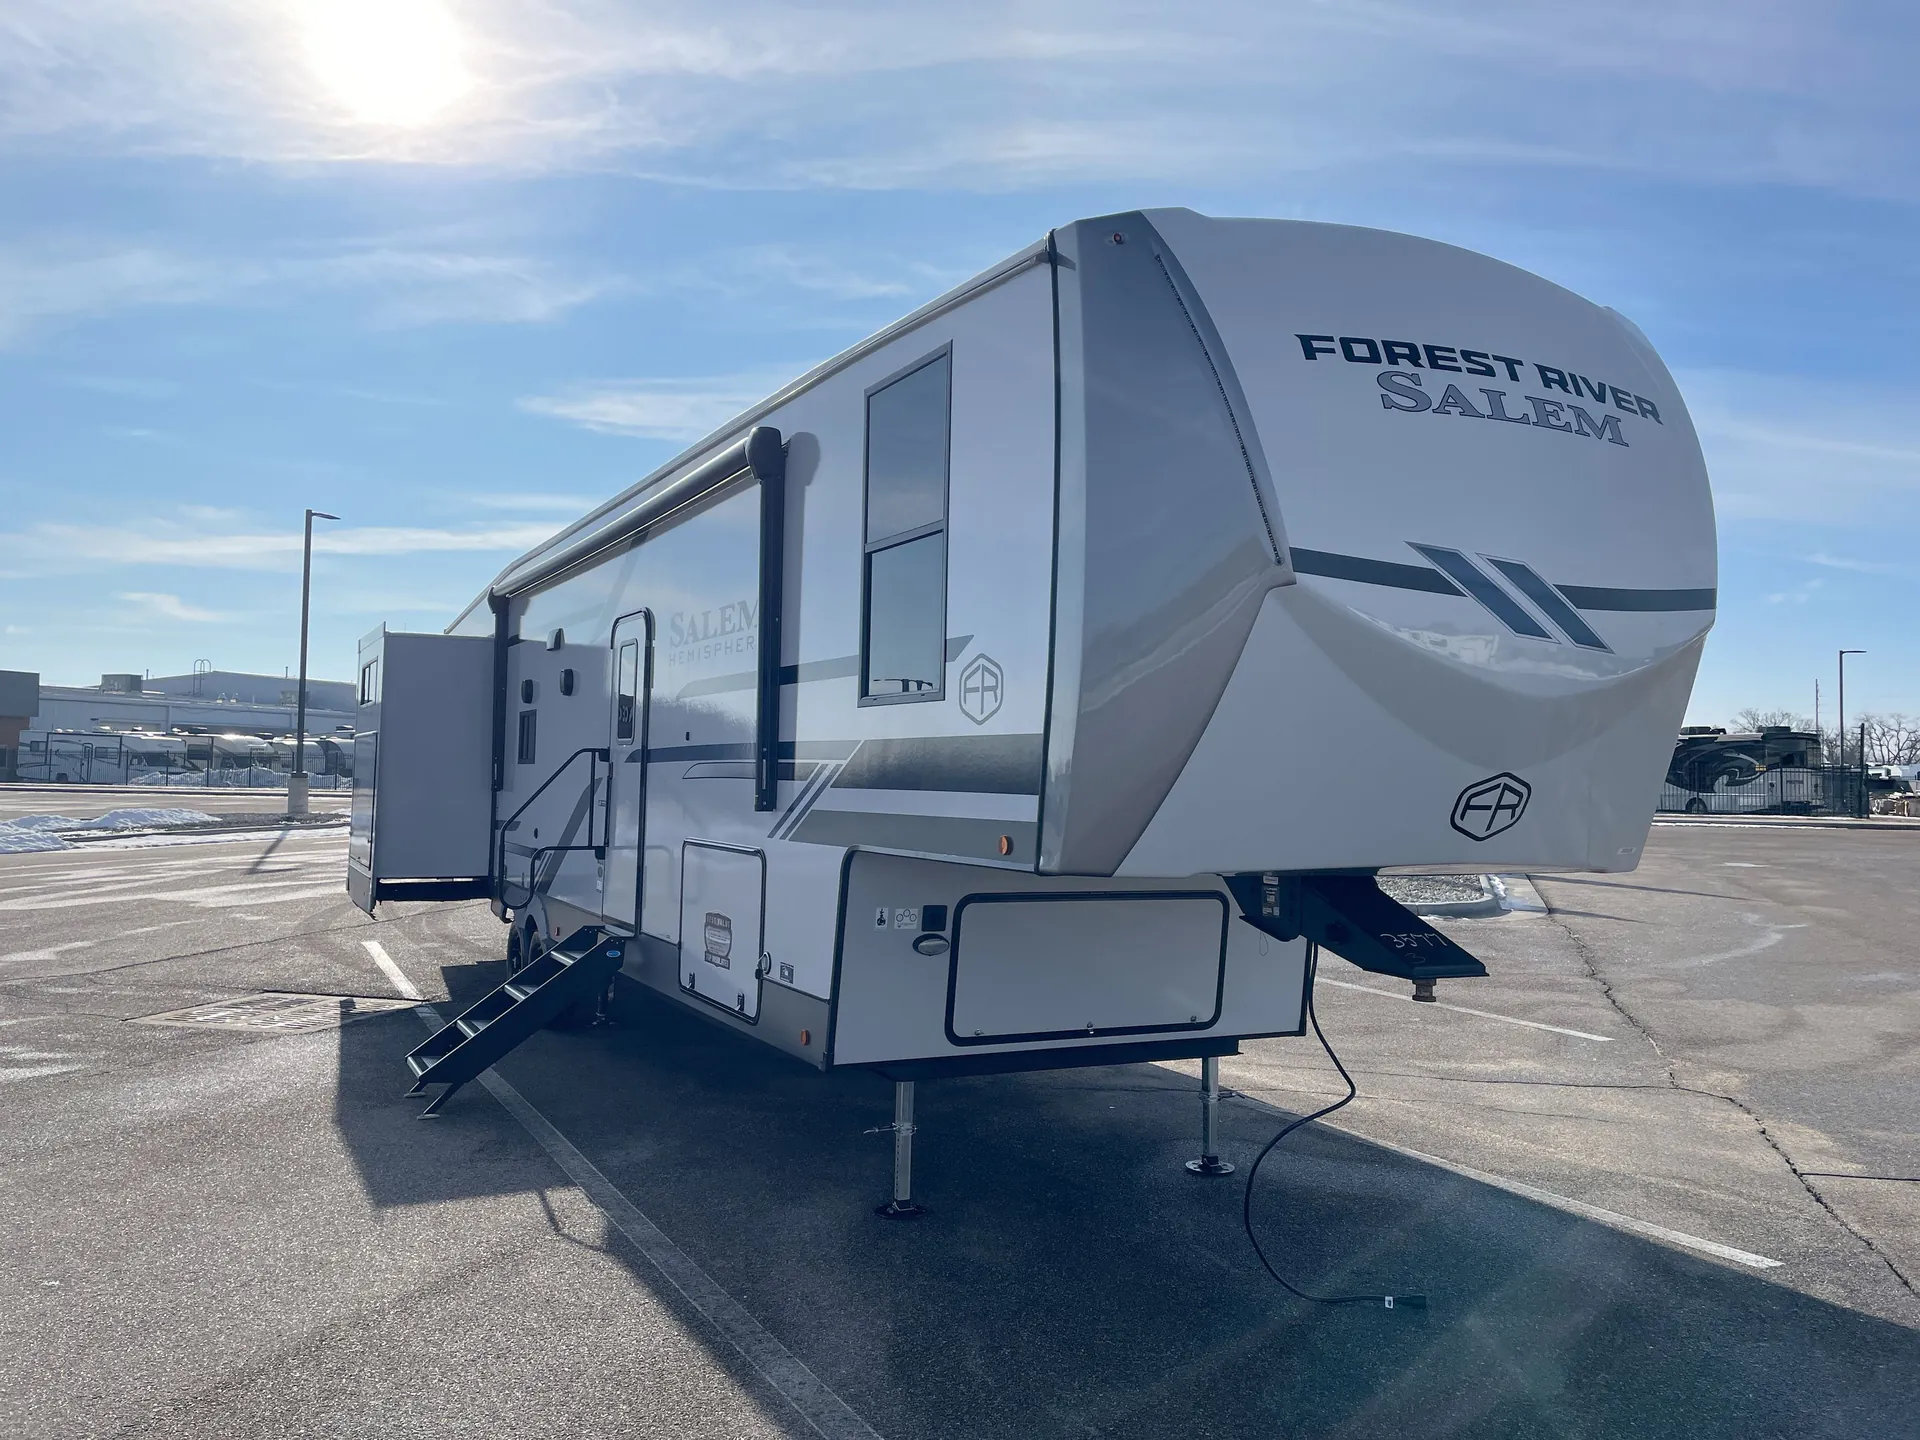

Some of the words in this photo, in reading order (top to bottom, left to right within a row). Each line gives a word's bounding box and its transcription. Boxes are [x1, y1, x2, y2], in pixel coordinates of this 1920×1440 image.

[1293, 333, 1525, 383] FOREST
[1532, 362, 1664, 426] RIVER
[1376, 370, 1630, 448] SALEM
[668, 635, 758, 668] HEMISPHER
[669, 599, 758, 649] SALEM
